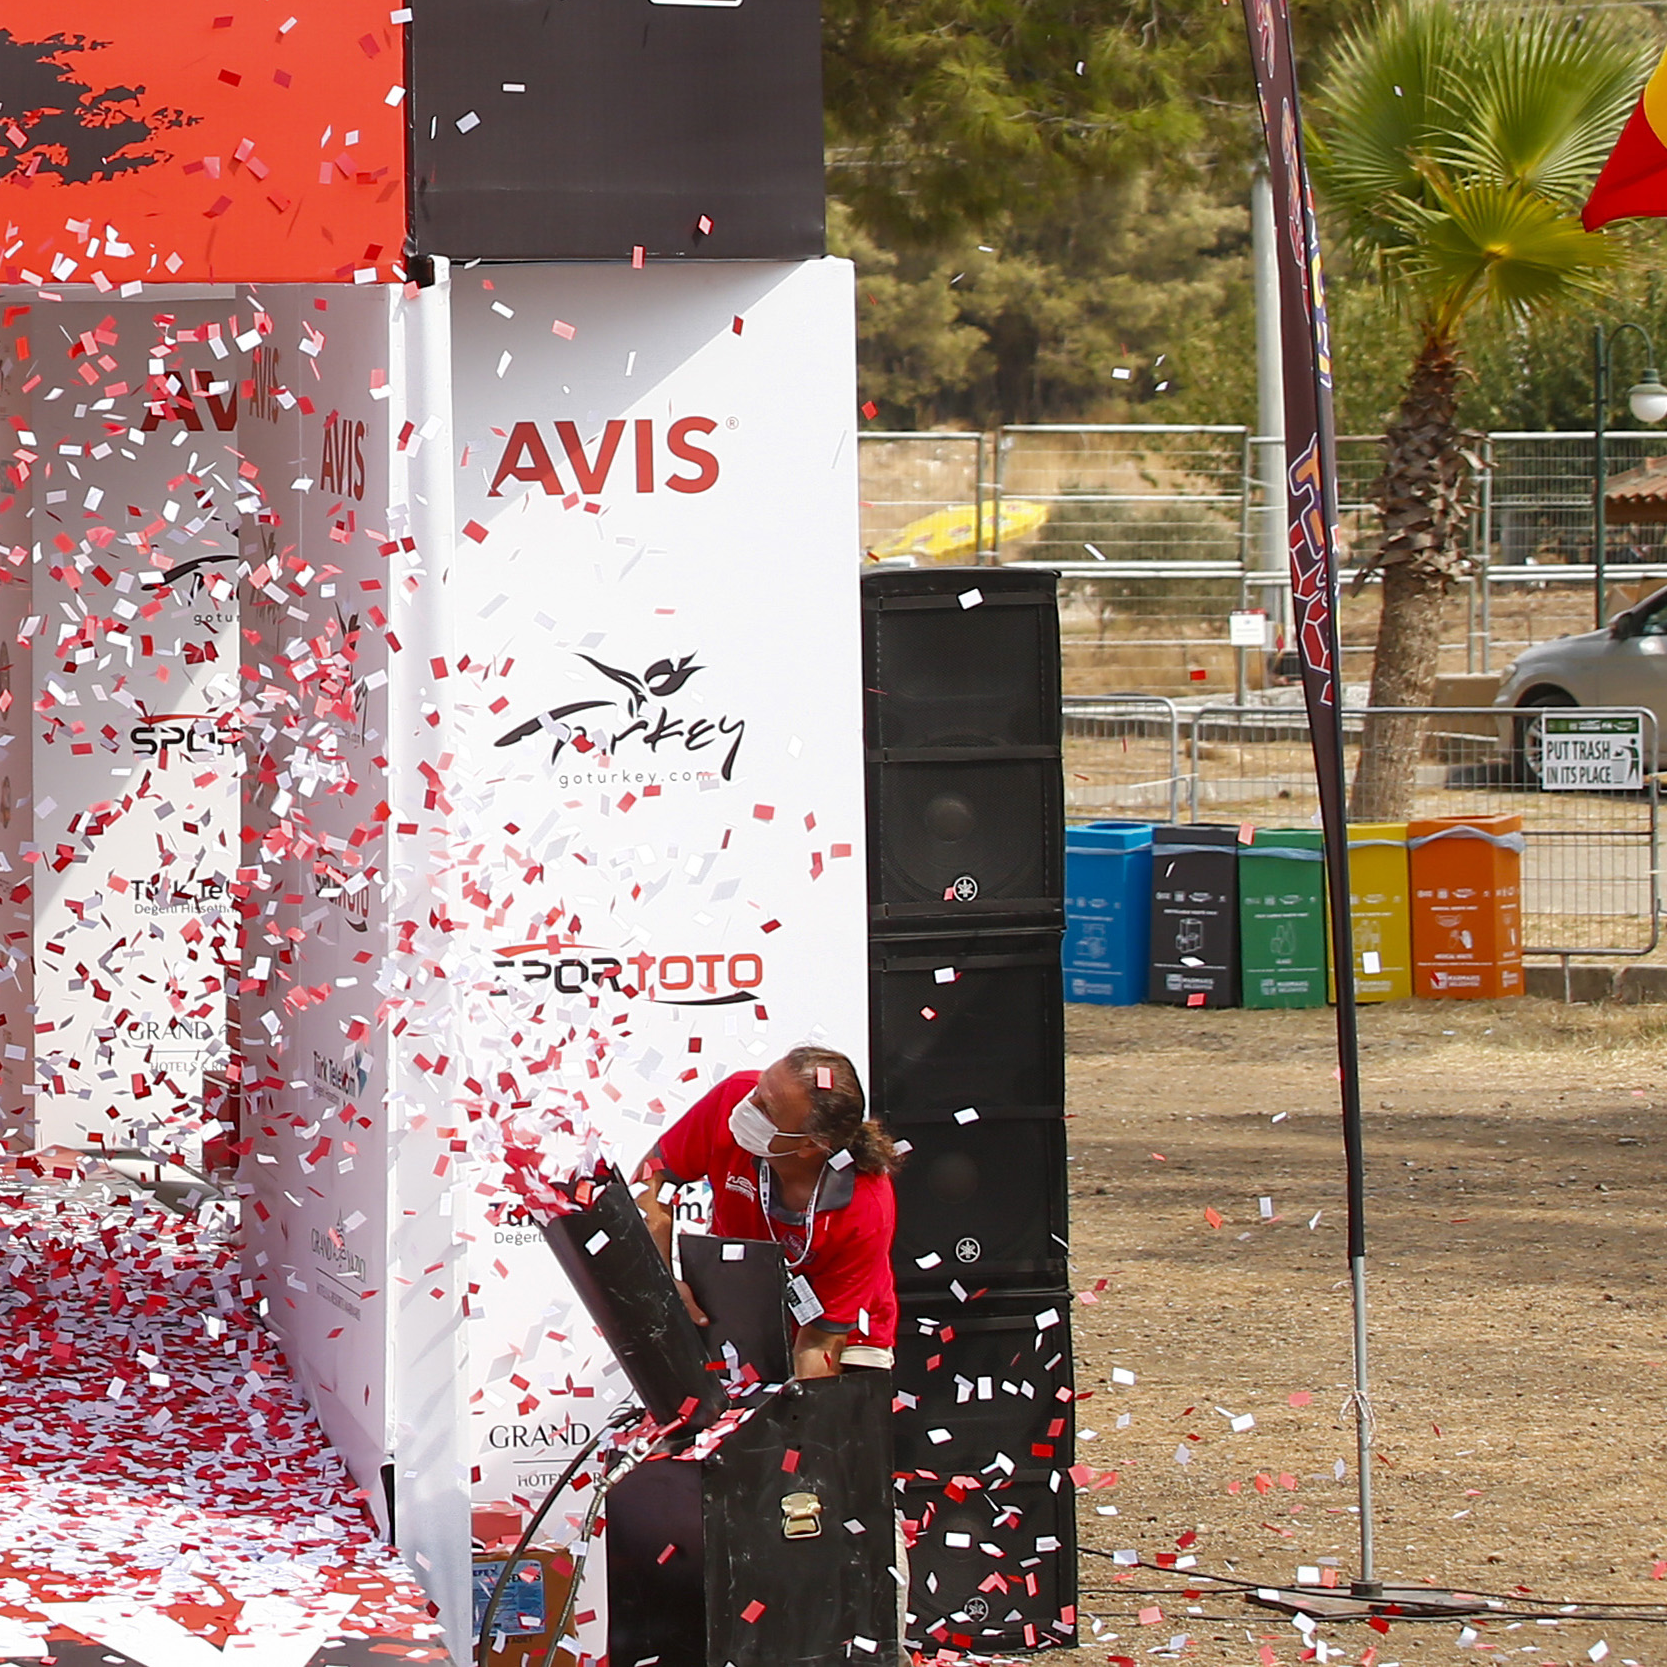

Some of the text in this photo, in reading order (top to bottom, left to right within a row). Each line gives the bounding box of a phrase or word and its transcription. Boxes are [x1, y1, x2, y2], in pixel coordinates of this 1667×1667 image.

[486, 416, 721, 498] AVIS
[1546, 740, 1611, 761] PUT TRASH
[558, 770, 713, 789] goturkey.com
[1546, 766, 1612, 784] IN ITS PLACE
[128, 1020, 210, 1041] GRAND
[489, 1423, 591, 1449] GRAND
